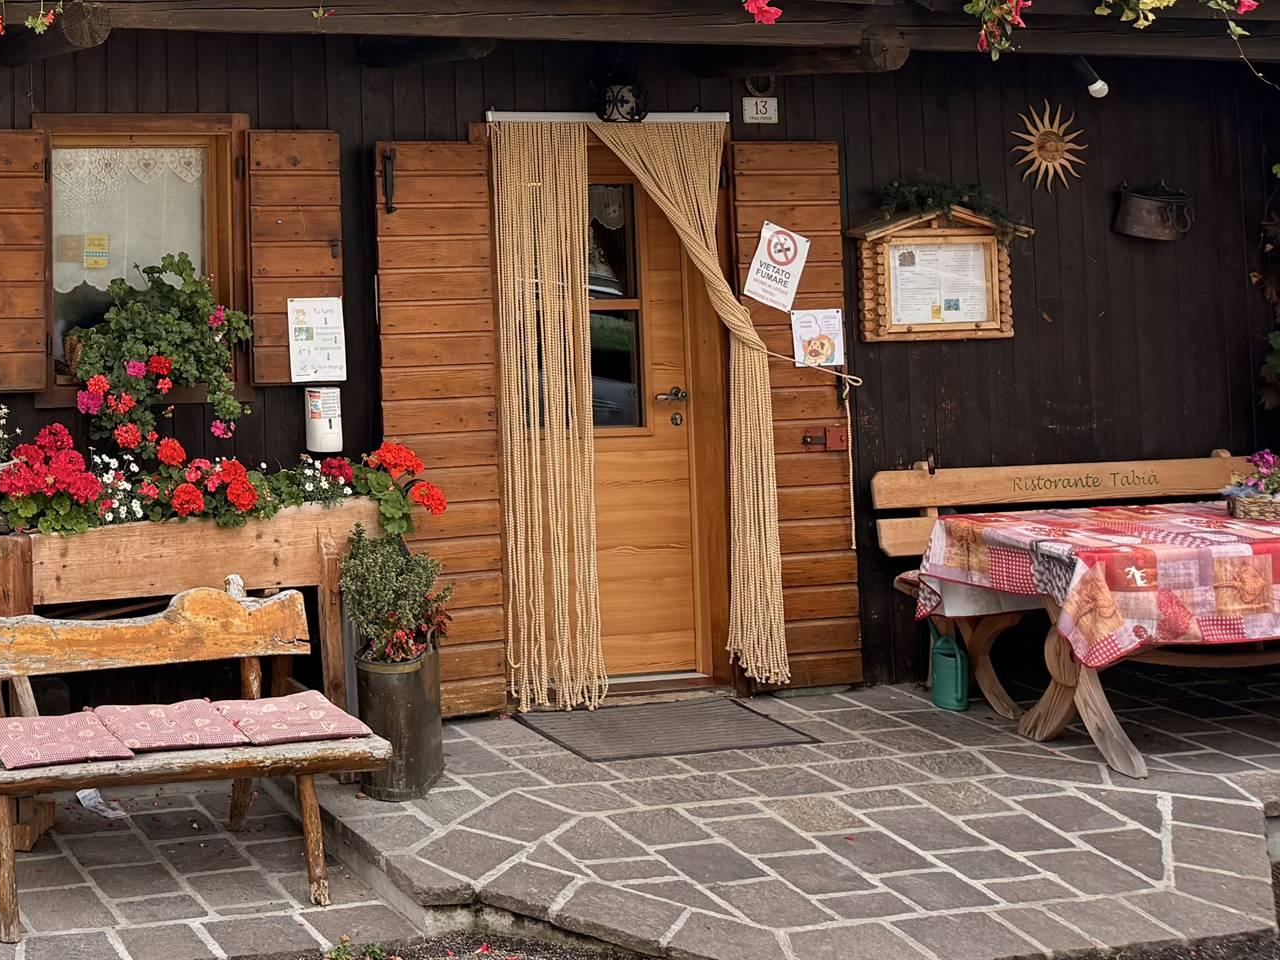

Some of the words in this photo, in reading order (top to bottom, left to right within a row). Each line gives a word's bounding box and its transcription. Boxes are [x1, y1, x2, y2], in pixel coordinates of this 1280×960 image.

[754, 100, 768, 115] 13
[756, 268, 789, 288] FUMARE
[760, 260, 791, 280] VIETATO
[1012, 473, 1102, 492] Ristorante
[1110, 470, 1159, 487] Tabià
